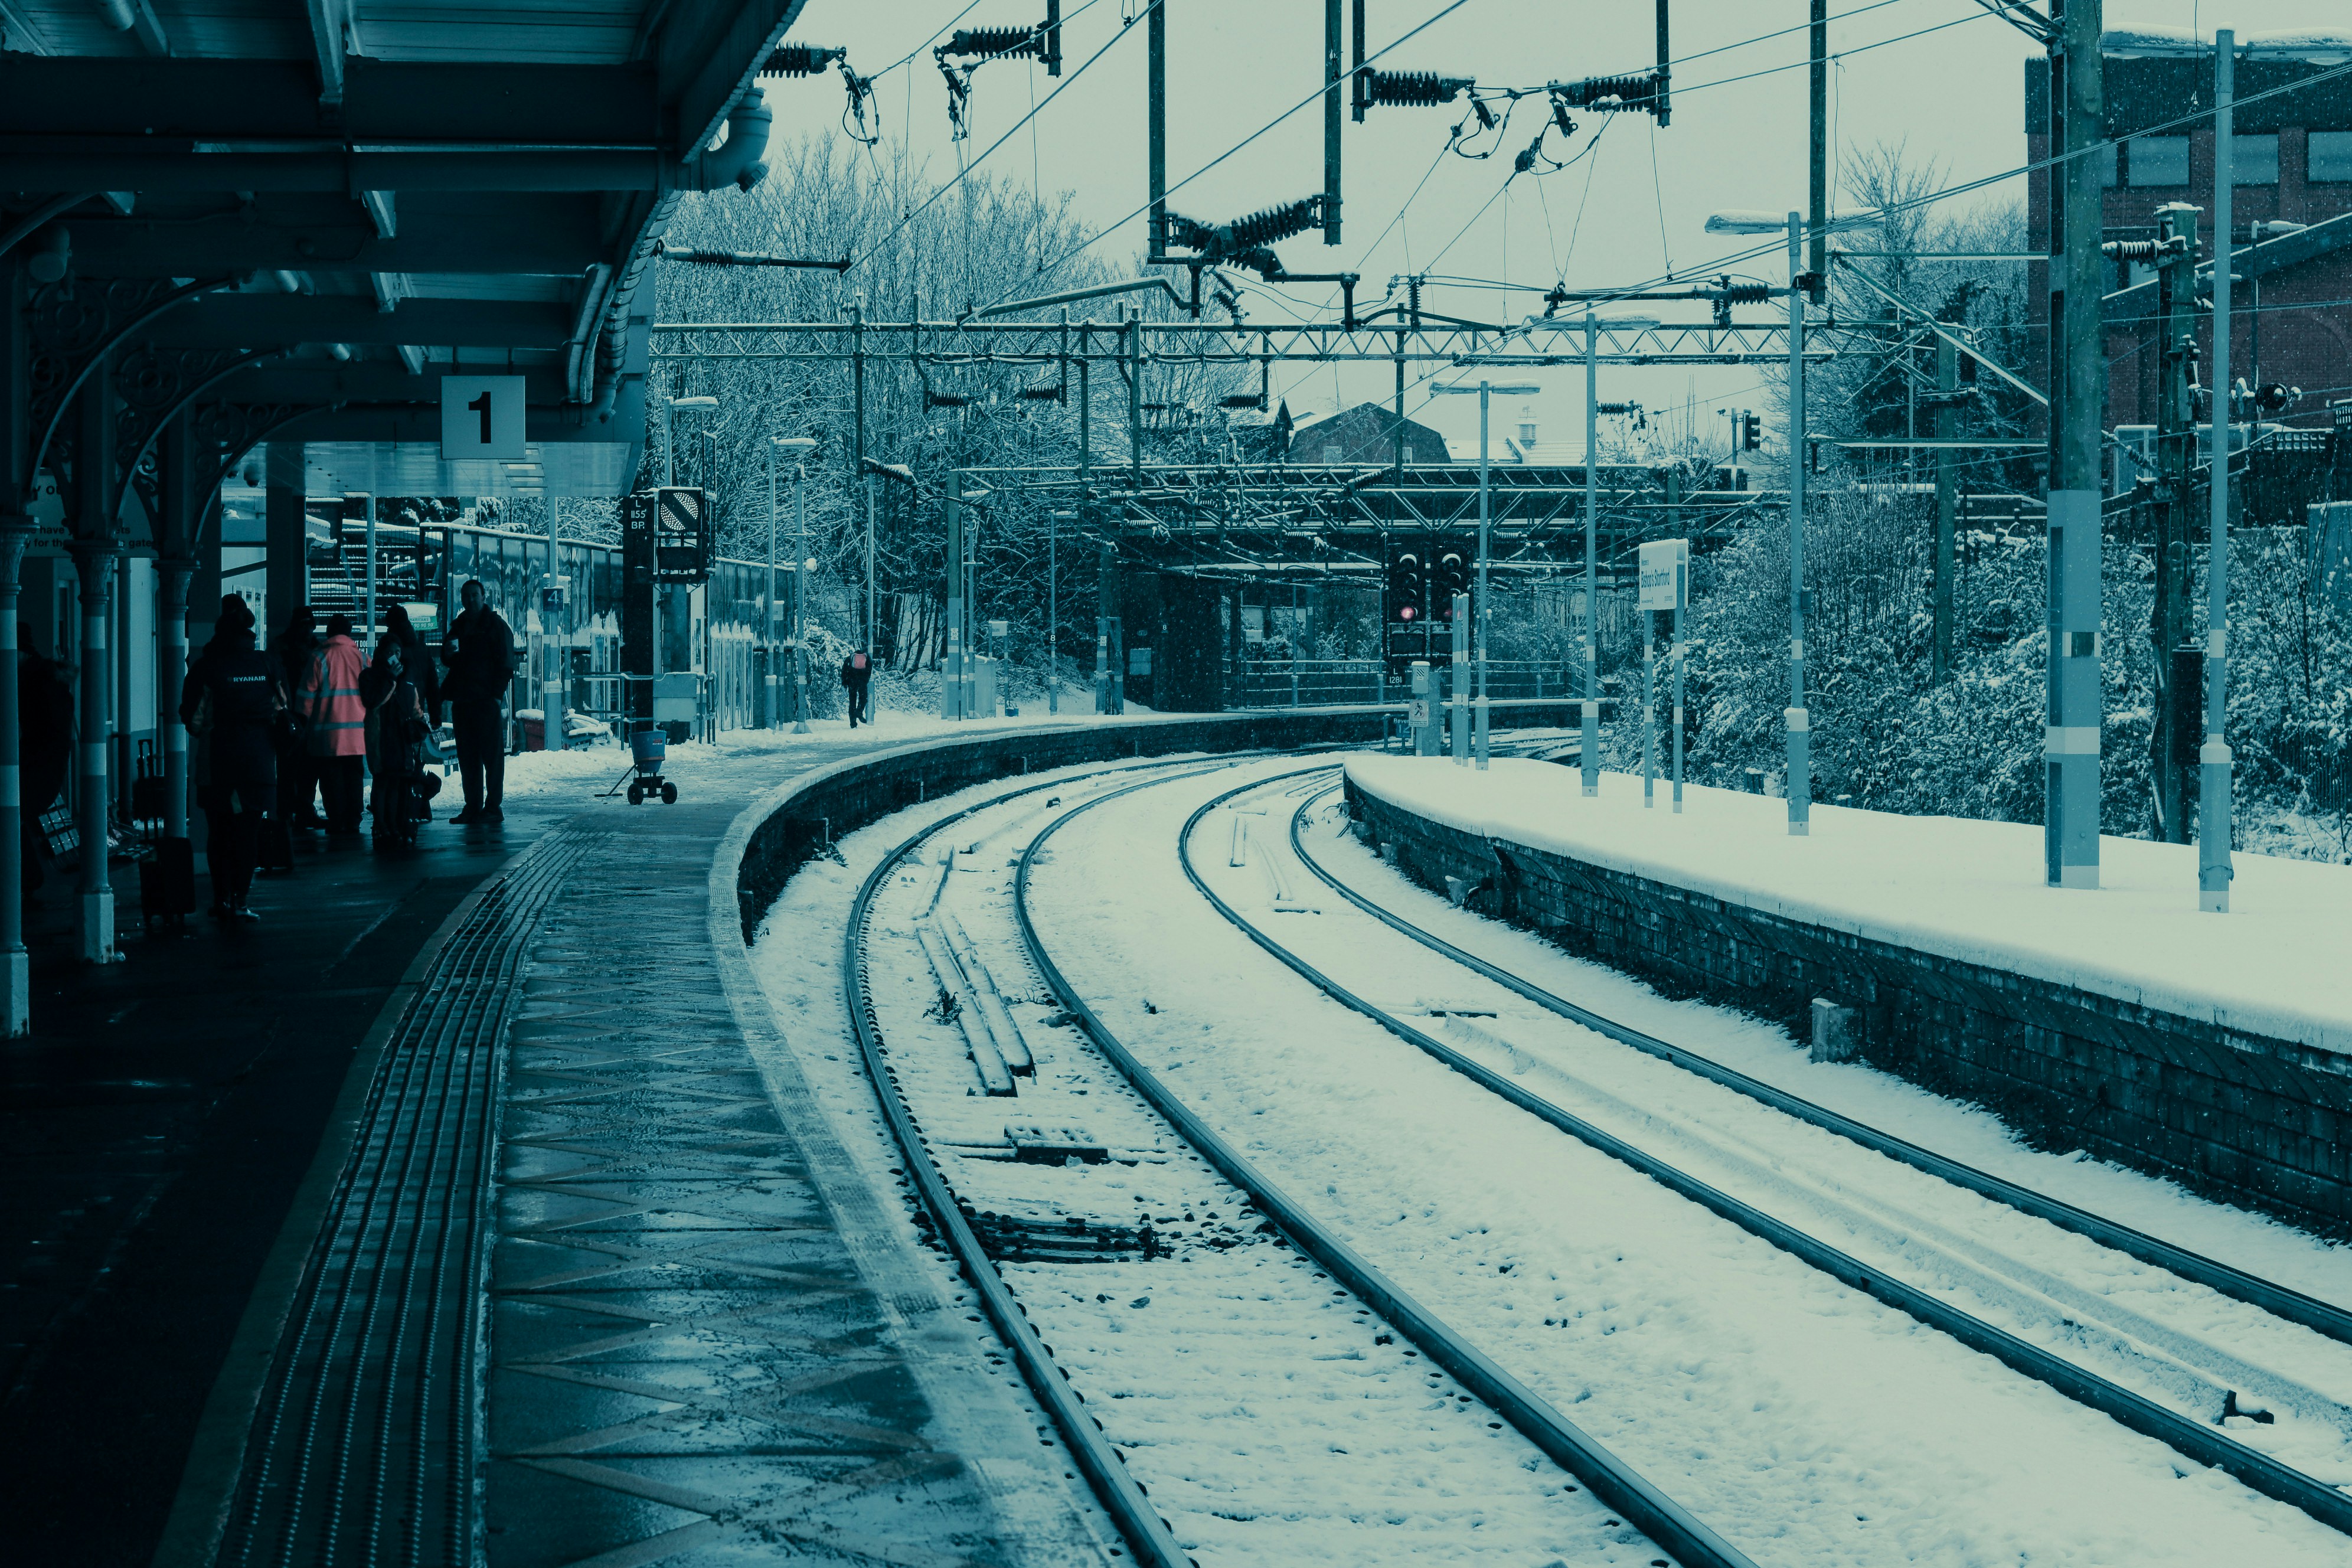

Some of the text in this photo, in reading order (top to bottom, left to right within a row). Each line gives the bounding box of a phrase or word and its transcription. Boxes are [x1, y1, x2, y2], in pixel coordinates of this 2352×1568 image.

[468, 391, 491, 444] 1
[631, 510, 645, 518] 1155
[40, 525, 65, 534] have
[34, 538, 49, 547] for
[52, 538, 63, 547] th
[1654, 567, 1670, 587] Stortford
[548, 590, 559, 605] 4
